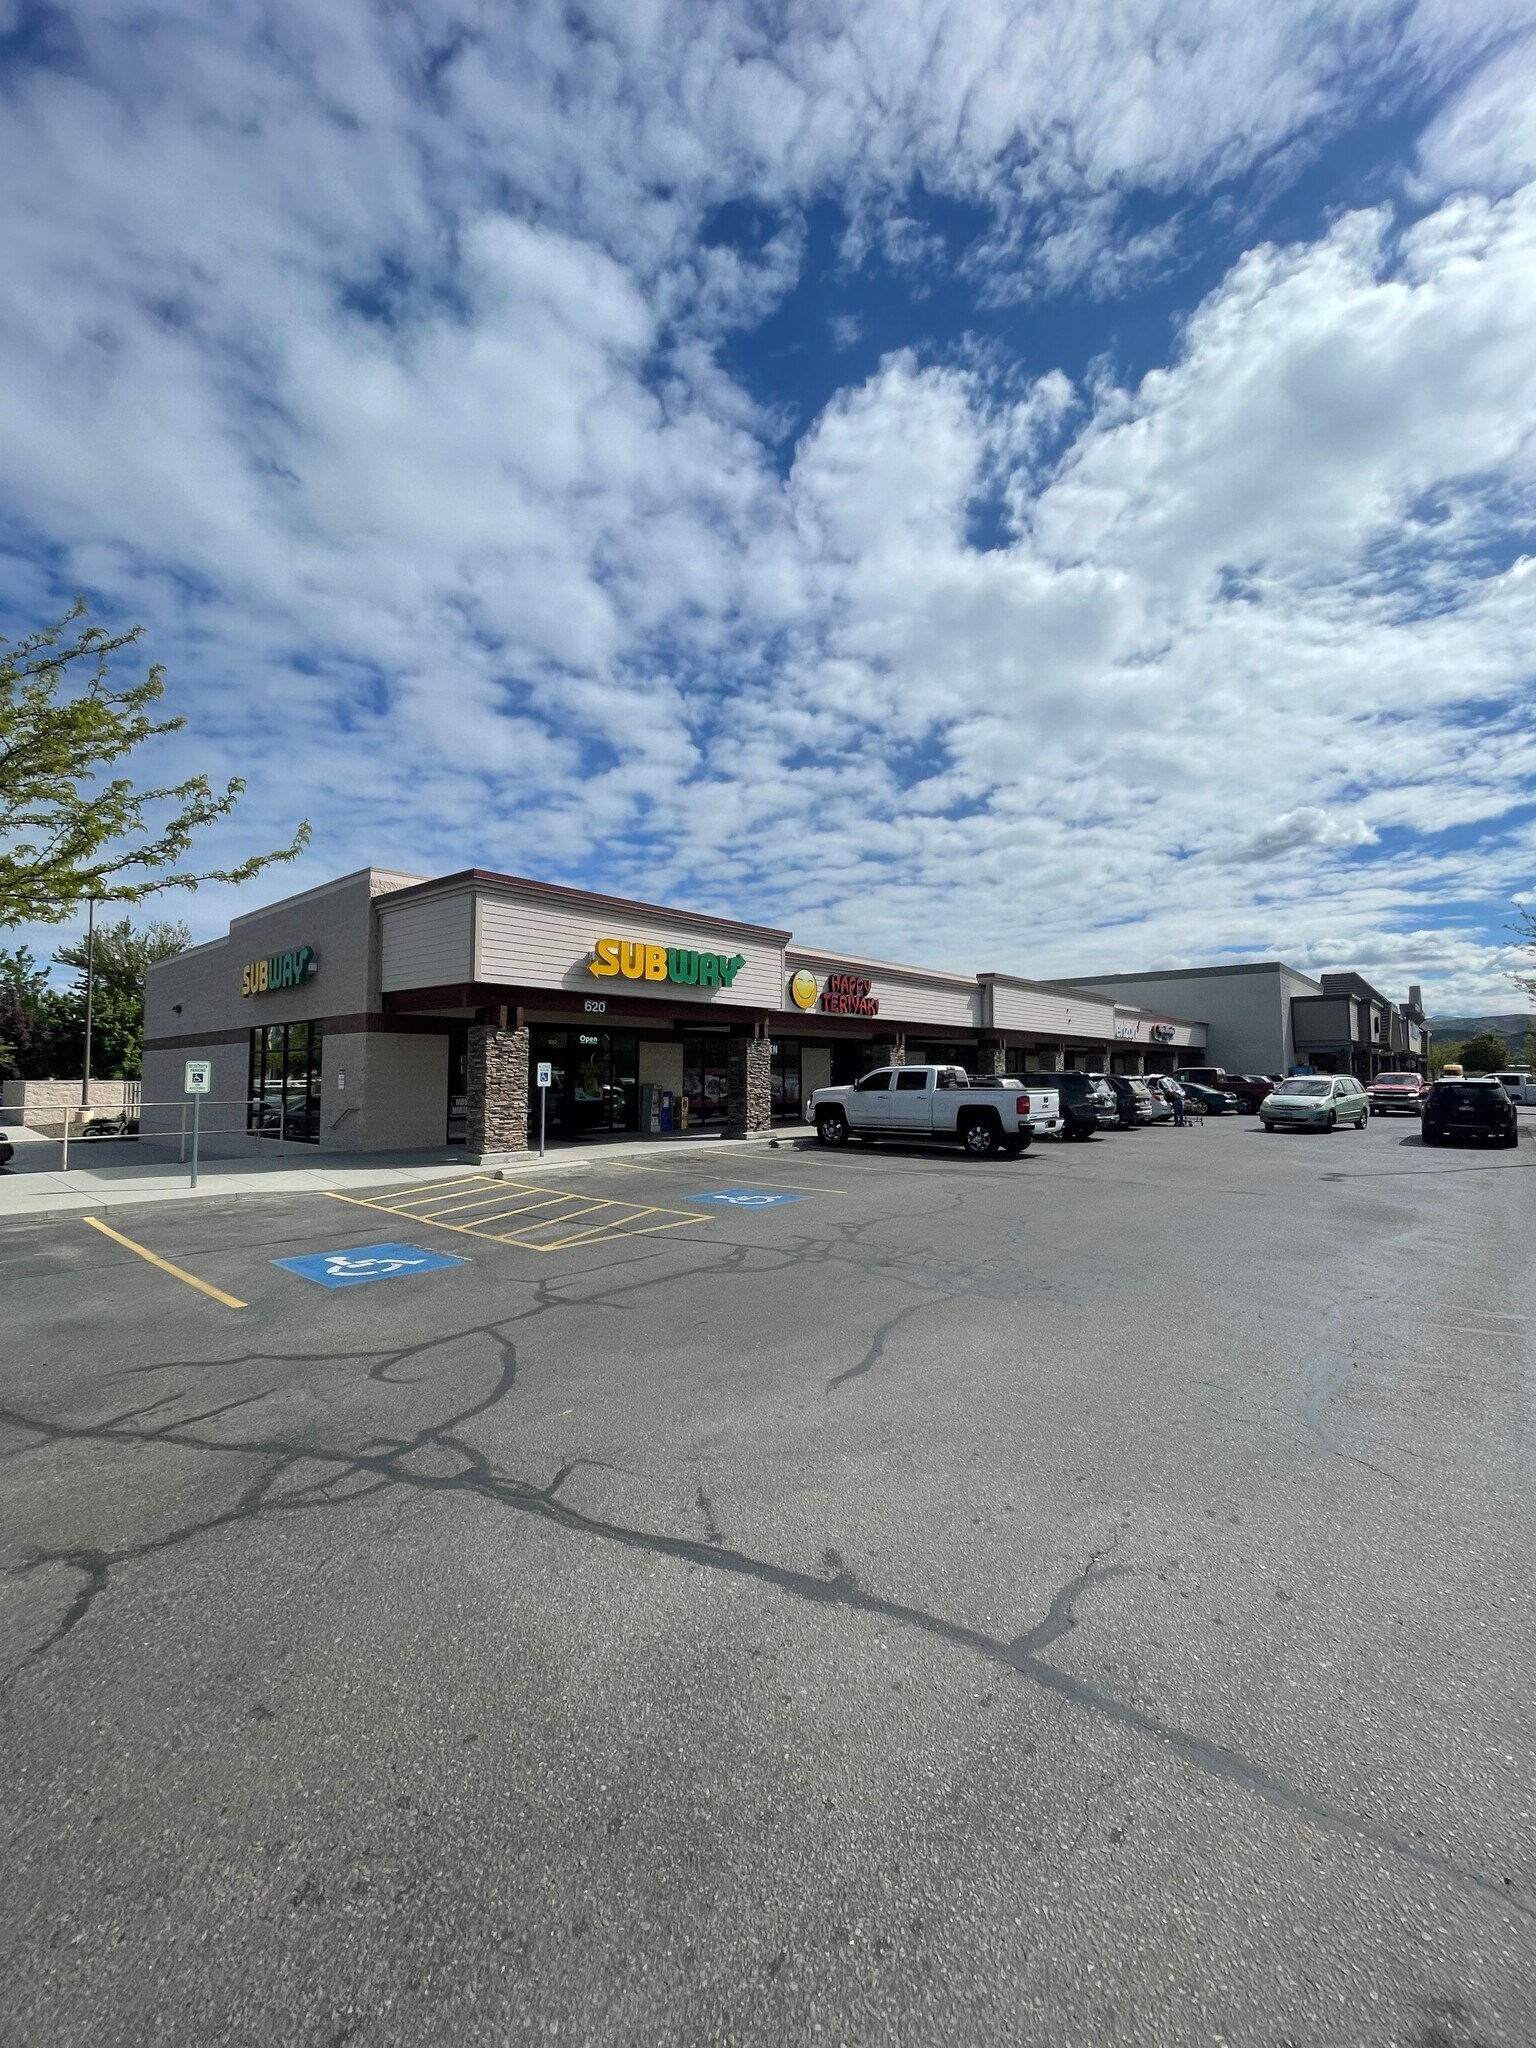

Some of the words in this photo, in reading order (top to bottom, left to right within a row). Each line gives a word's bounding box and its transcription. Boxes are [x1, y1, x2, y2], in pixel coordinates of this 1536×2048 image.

[241, 946, 312, 997] SUBWAY
[588, 938, 746, 988] SUBWAY
[829, 974, 872, 996] HAPPY
[584, 1000, 606, 1013] 620
[821, 993, 880, 1015] TERIYAKI
[579, 1034, 598, 1044] Open
